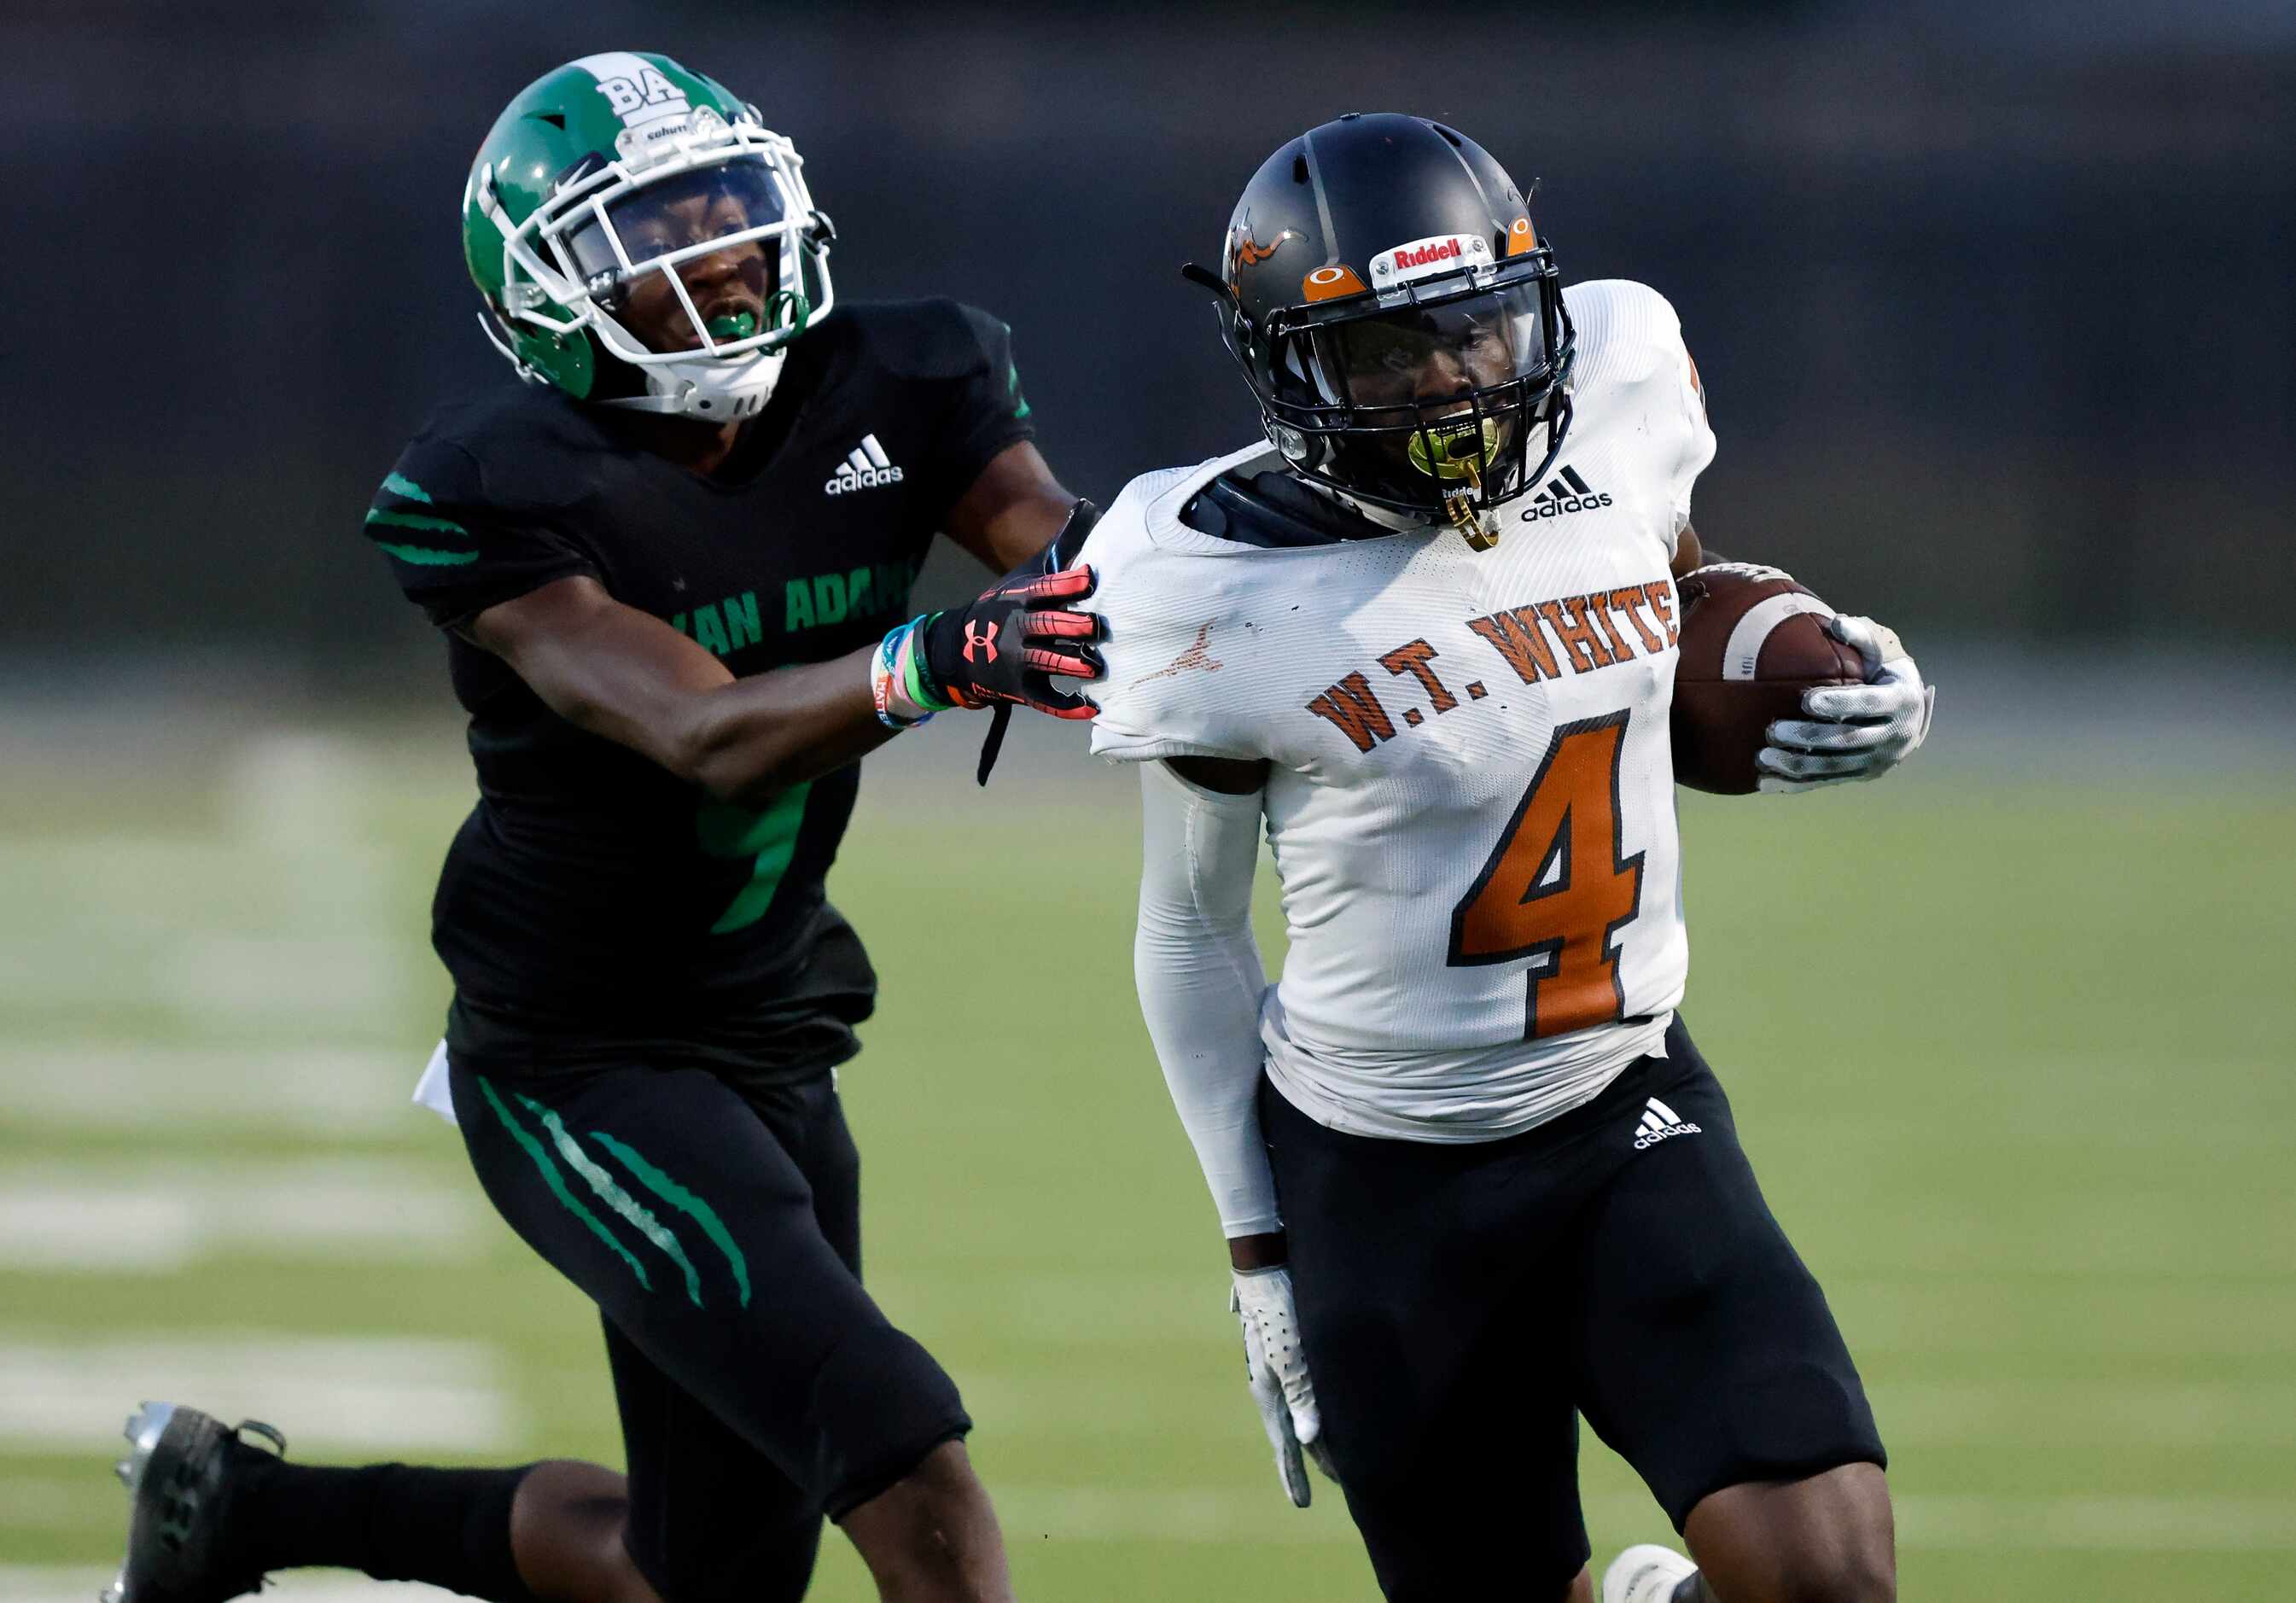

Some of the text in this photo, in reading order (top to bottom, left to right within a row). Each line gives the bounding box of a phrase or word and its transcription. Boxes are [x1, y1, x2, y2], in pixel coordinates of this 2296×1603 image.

[595, 67, 686, 117] BA
[1394, 238, 1461, 270] Riddell
[825, 466, 904, 495] adidas
[1521, 493, 1612, 522] adidas
[1305, 580, 1678, 754] W.T. WHITE
[1447, 707, 1646, 1040] 4
[1634, 1123, 1702, 1149] adidas
